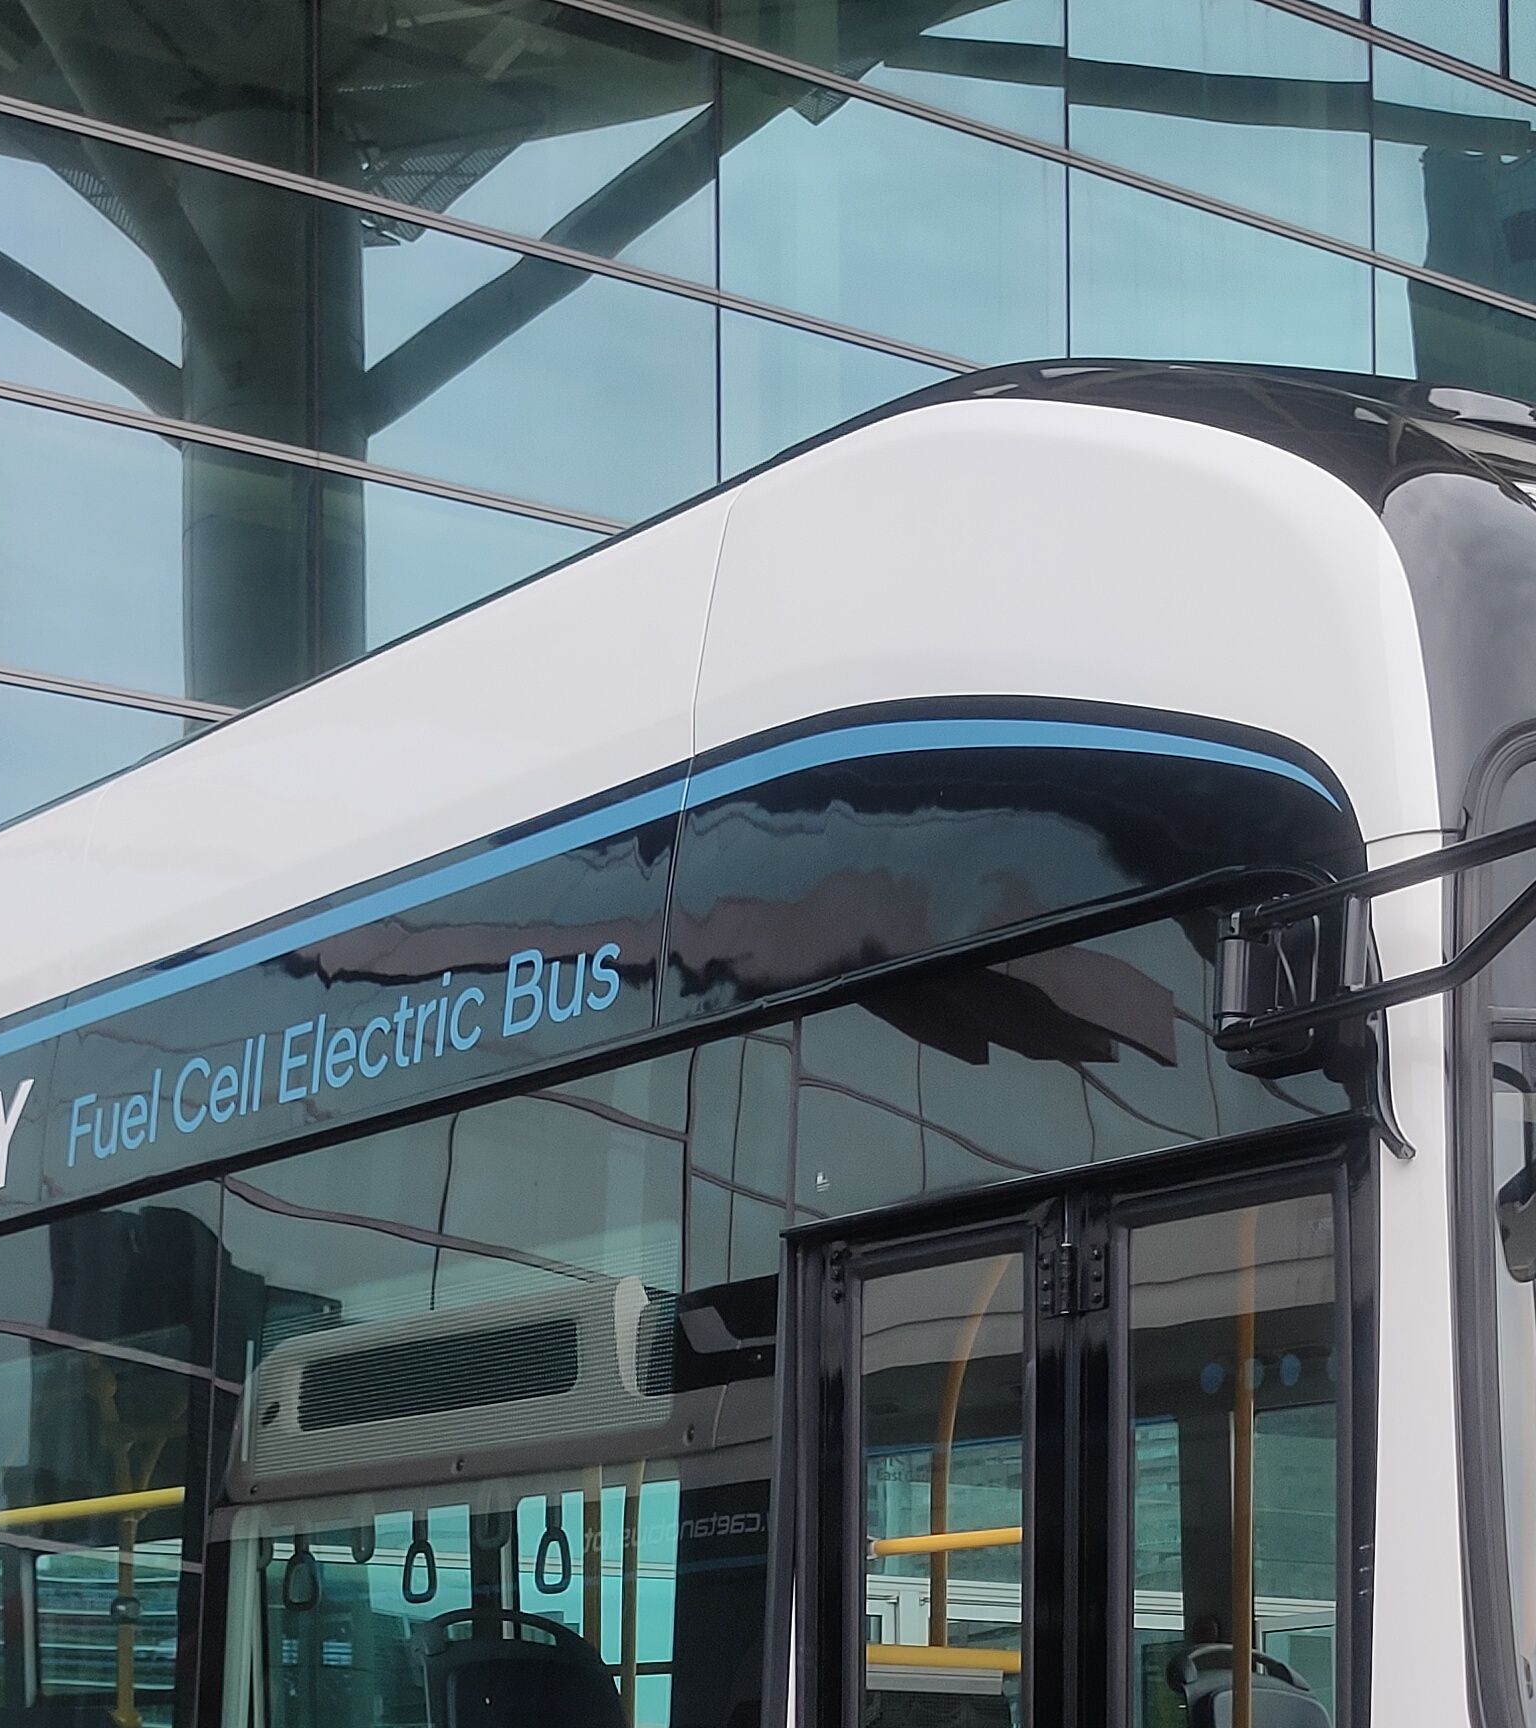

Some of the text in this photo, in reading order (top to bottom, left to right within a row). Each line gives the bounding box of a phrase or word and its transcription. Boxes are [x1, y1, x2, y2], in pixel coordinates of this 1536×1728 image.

[67, 942, 622, 1168] Fuel Cell Electric Bus
